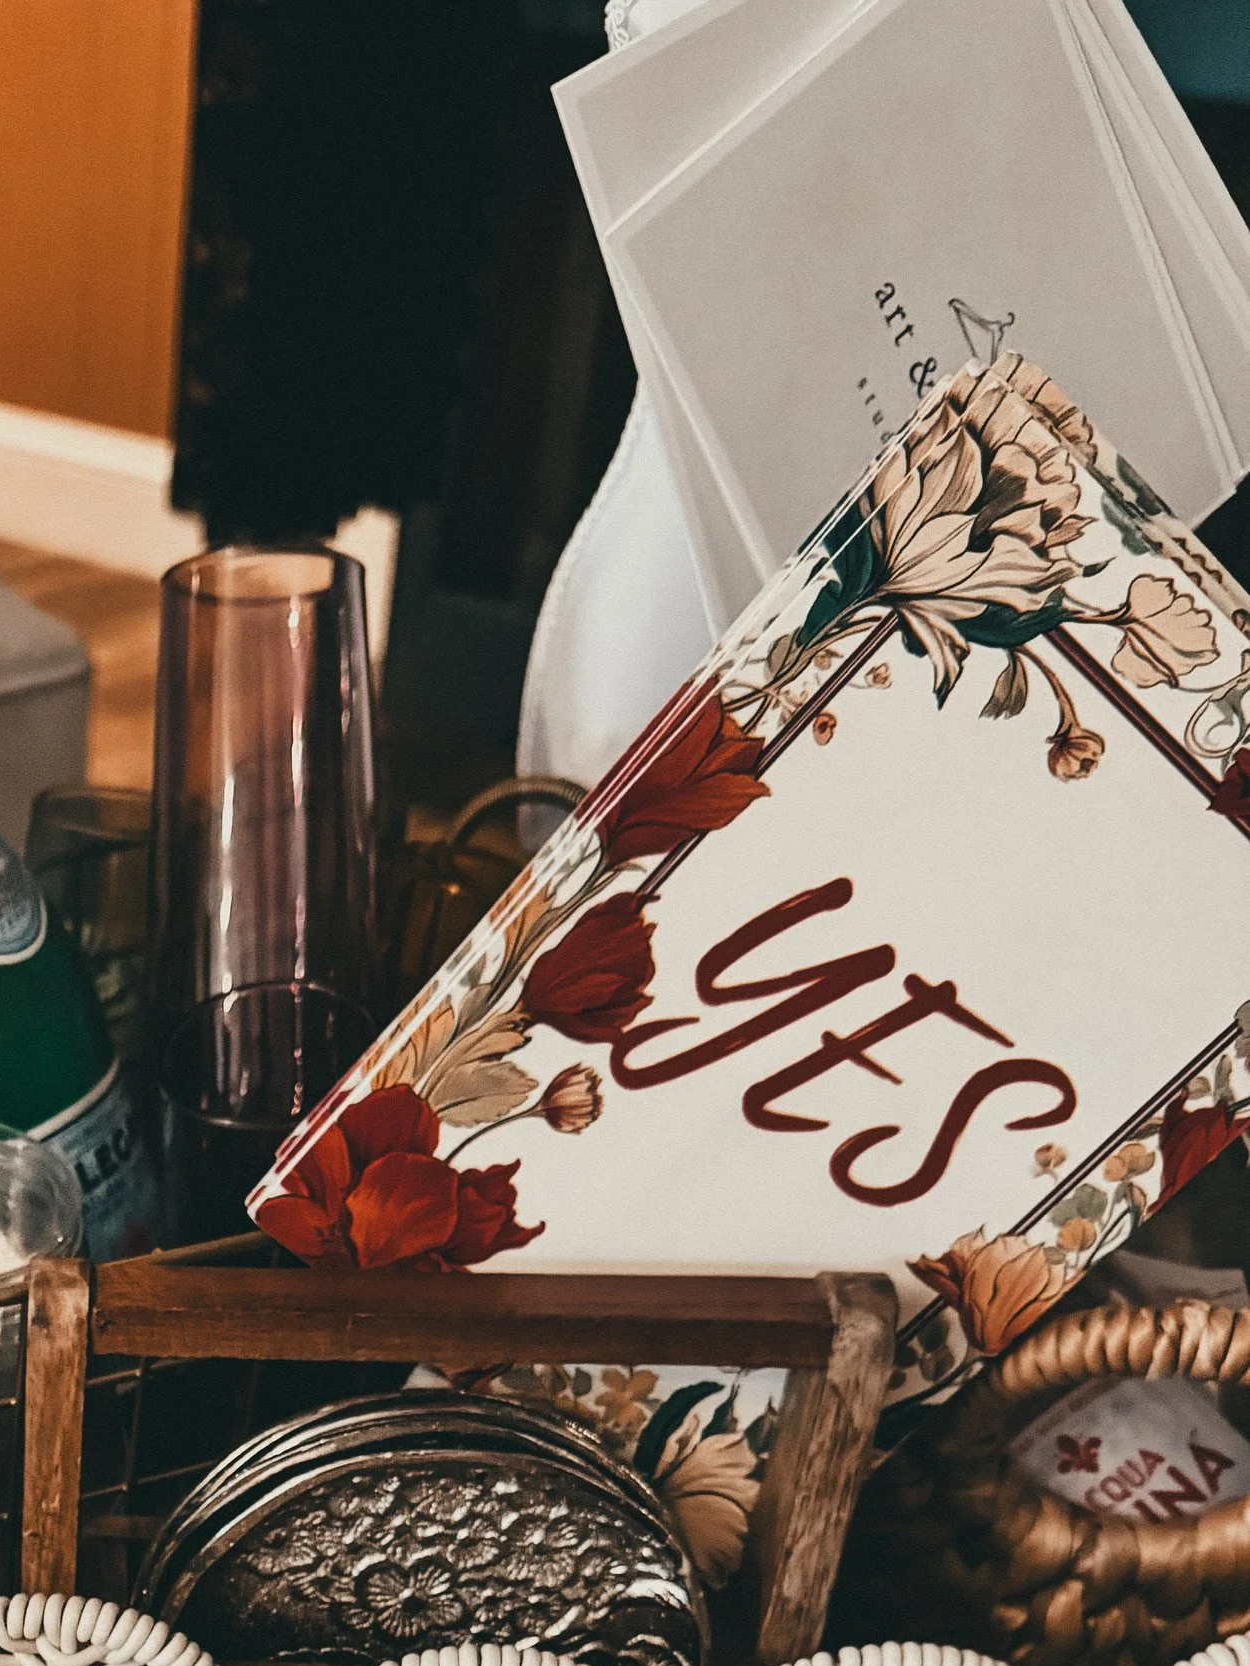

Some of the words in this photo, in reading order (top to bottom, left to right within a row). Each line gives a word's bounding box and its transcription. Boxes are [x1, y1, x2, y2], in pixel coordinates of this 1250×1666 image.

[875, 282, 914, 347] art
[909, 356, 937, 399] &
[610, 878, 1076, 1207] YES
[1083, 1449, 1166, 1510] CQUA
